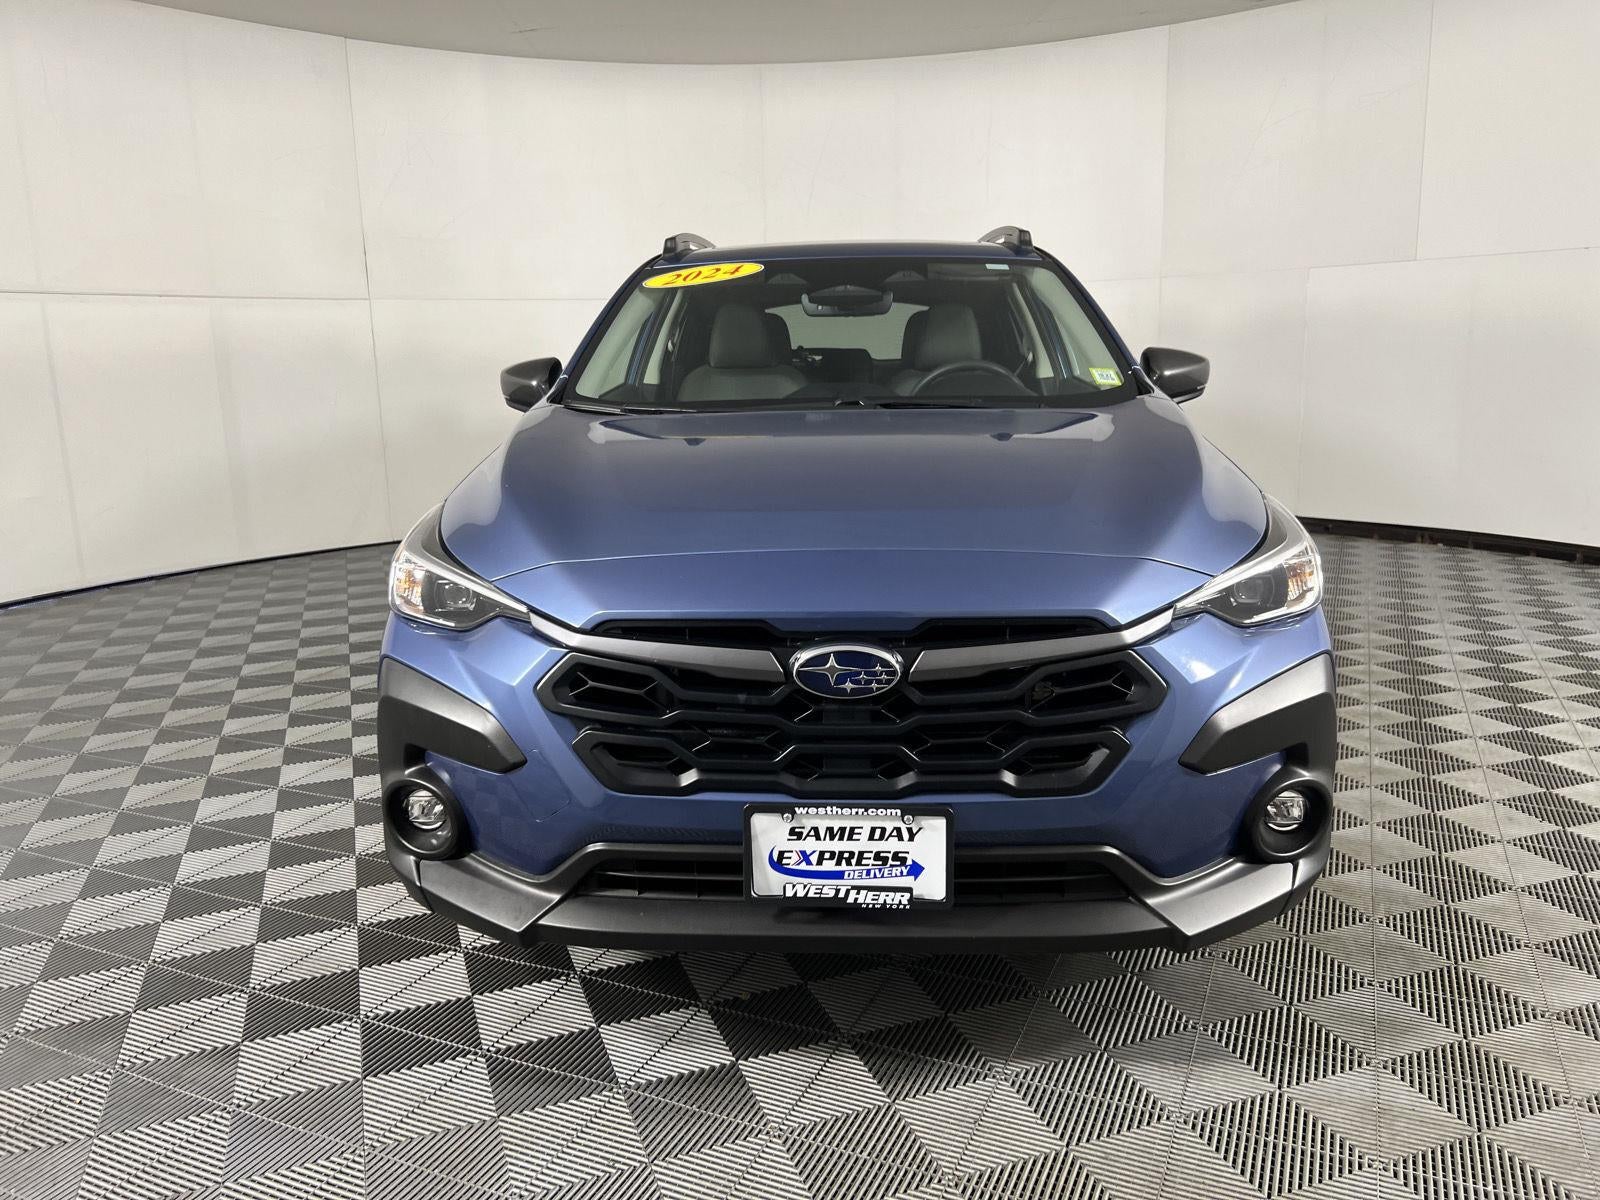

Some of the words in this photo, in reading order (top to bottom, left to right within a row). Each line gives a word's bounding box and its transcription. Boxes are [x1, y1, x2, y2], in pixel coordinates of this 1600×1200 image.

[662, 265, 744, 285] 2024
[795, 806, 901, 816] westherr.com
[787, 826, 863, 842] SAME
[867, 826, 923, 842] DAY
[776, 850, 910, 866] EXPRESS
[843, 866, 910, 880] DELIVERY
